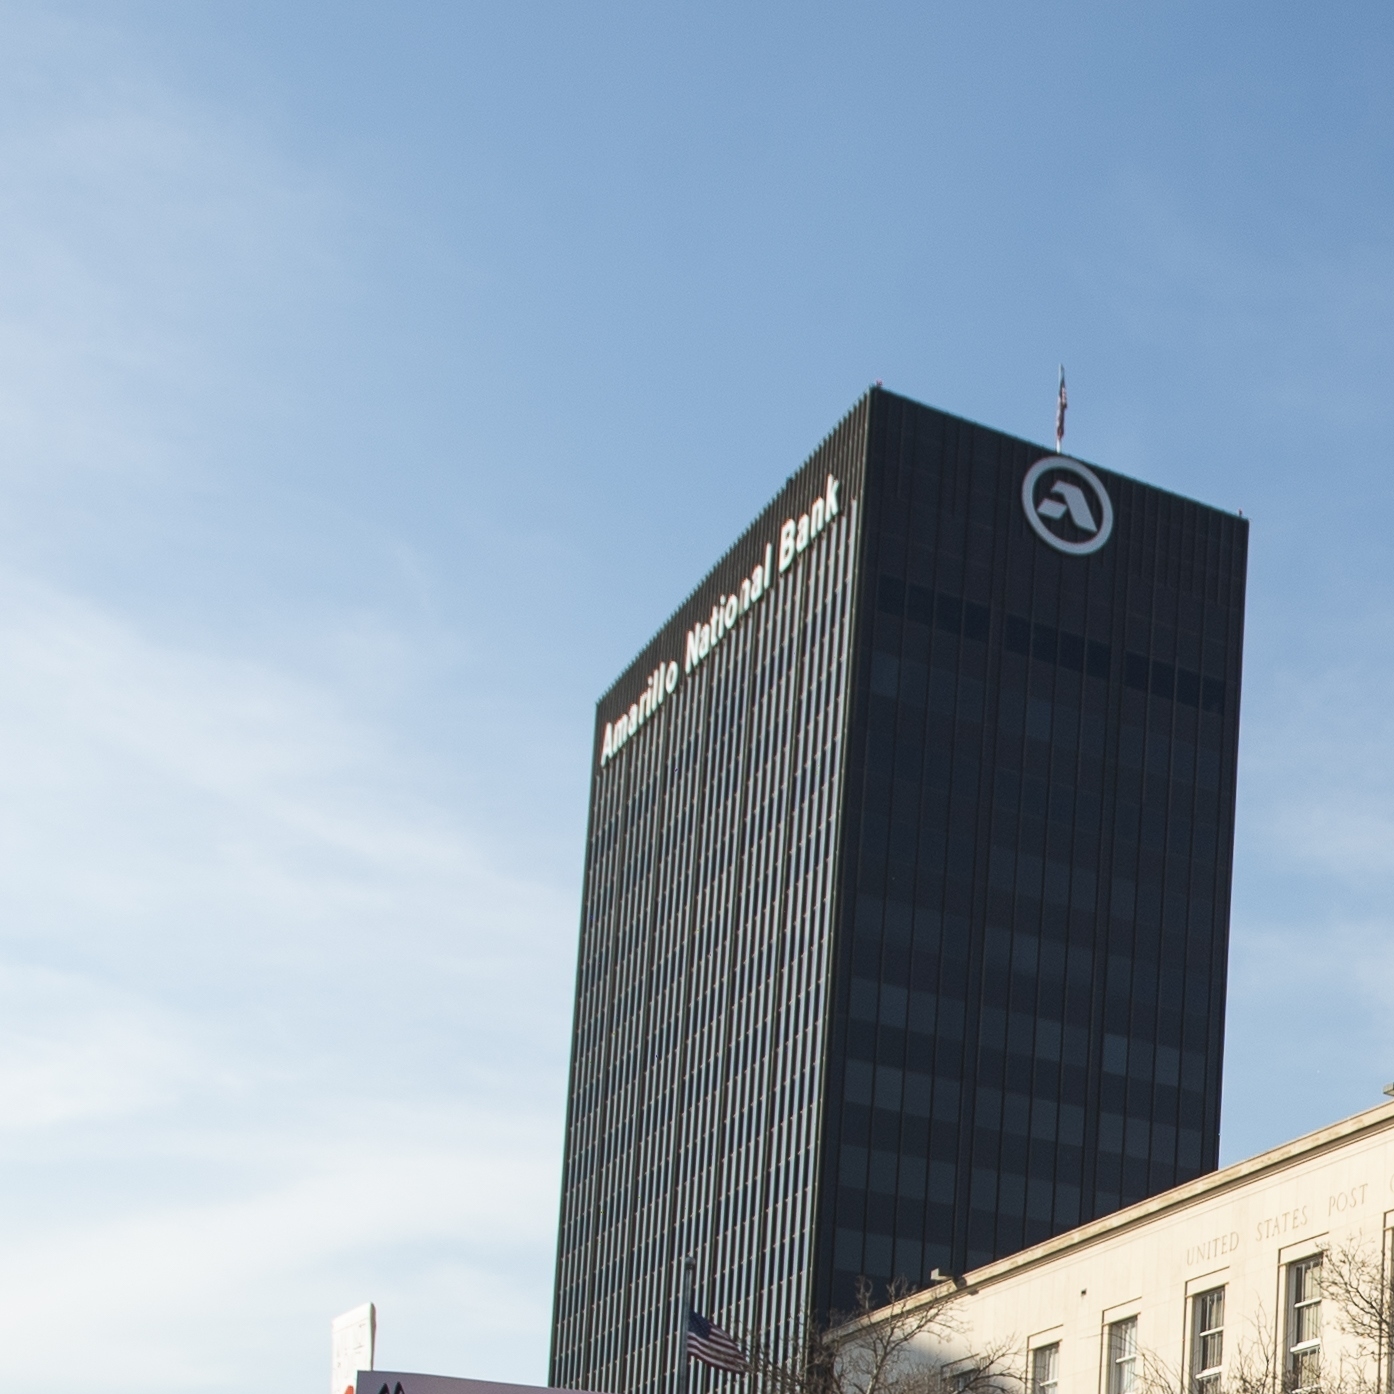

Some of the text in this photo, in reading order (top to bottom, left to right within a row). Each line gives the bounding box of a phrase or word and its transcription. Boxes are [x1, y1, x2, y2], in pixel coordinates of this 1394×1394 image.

[601, 474, 840, 768] Amarillo National Bank
[1185, 1230, 1240, 1267] UNITED
[1255, 1205, 1309, 1242] STATES
[1328, 1183, 1369, 1217] POST
